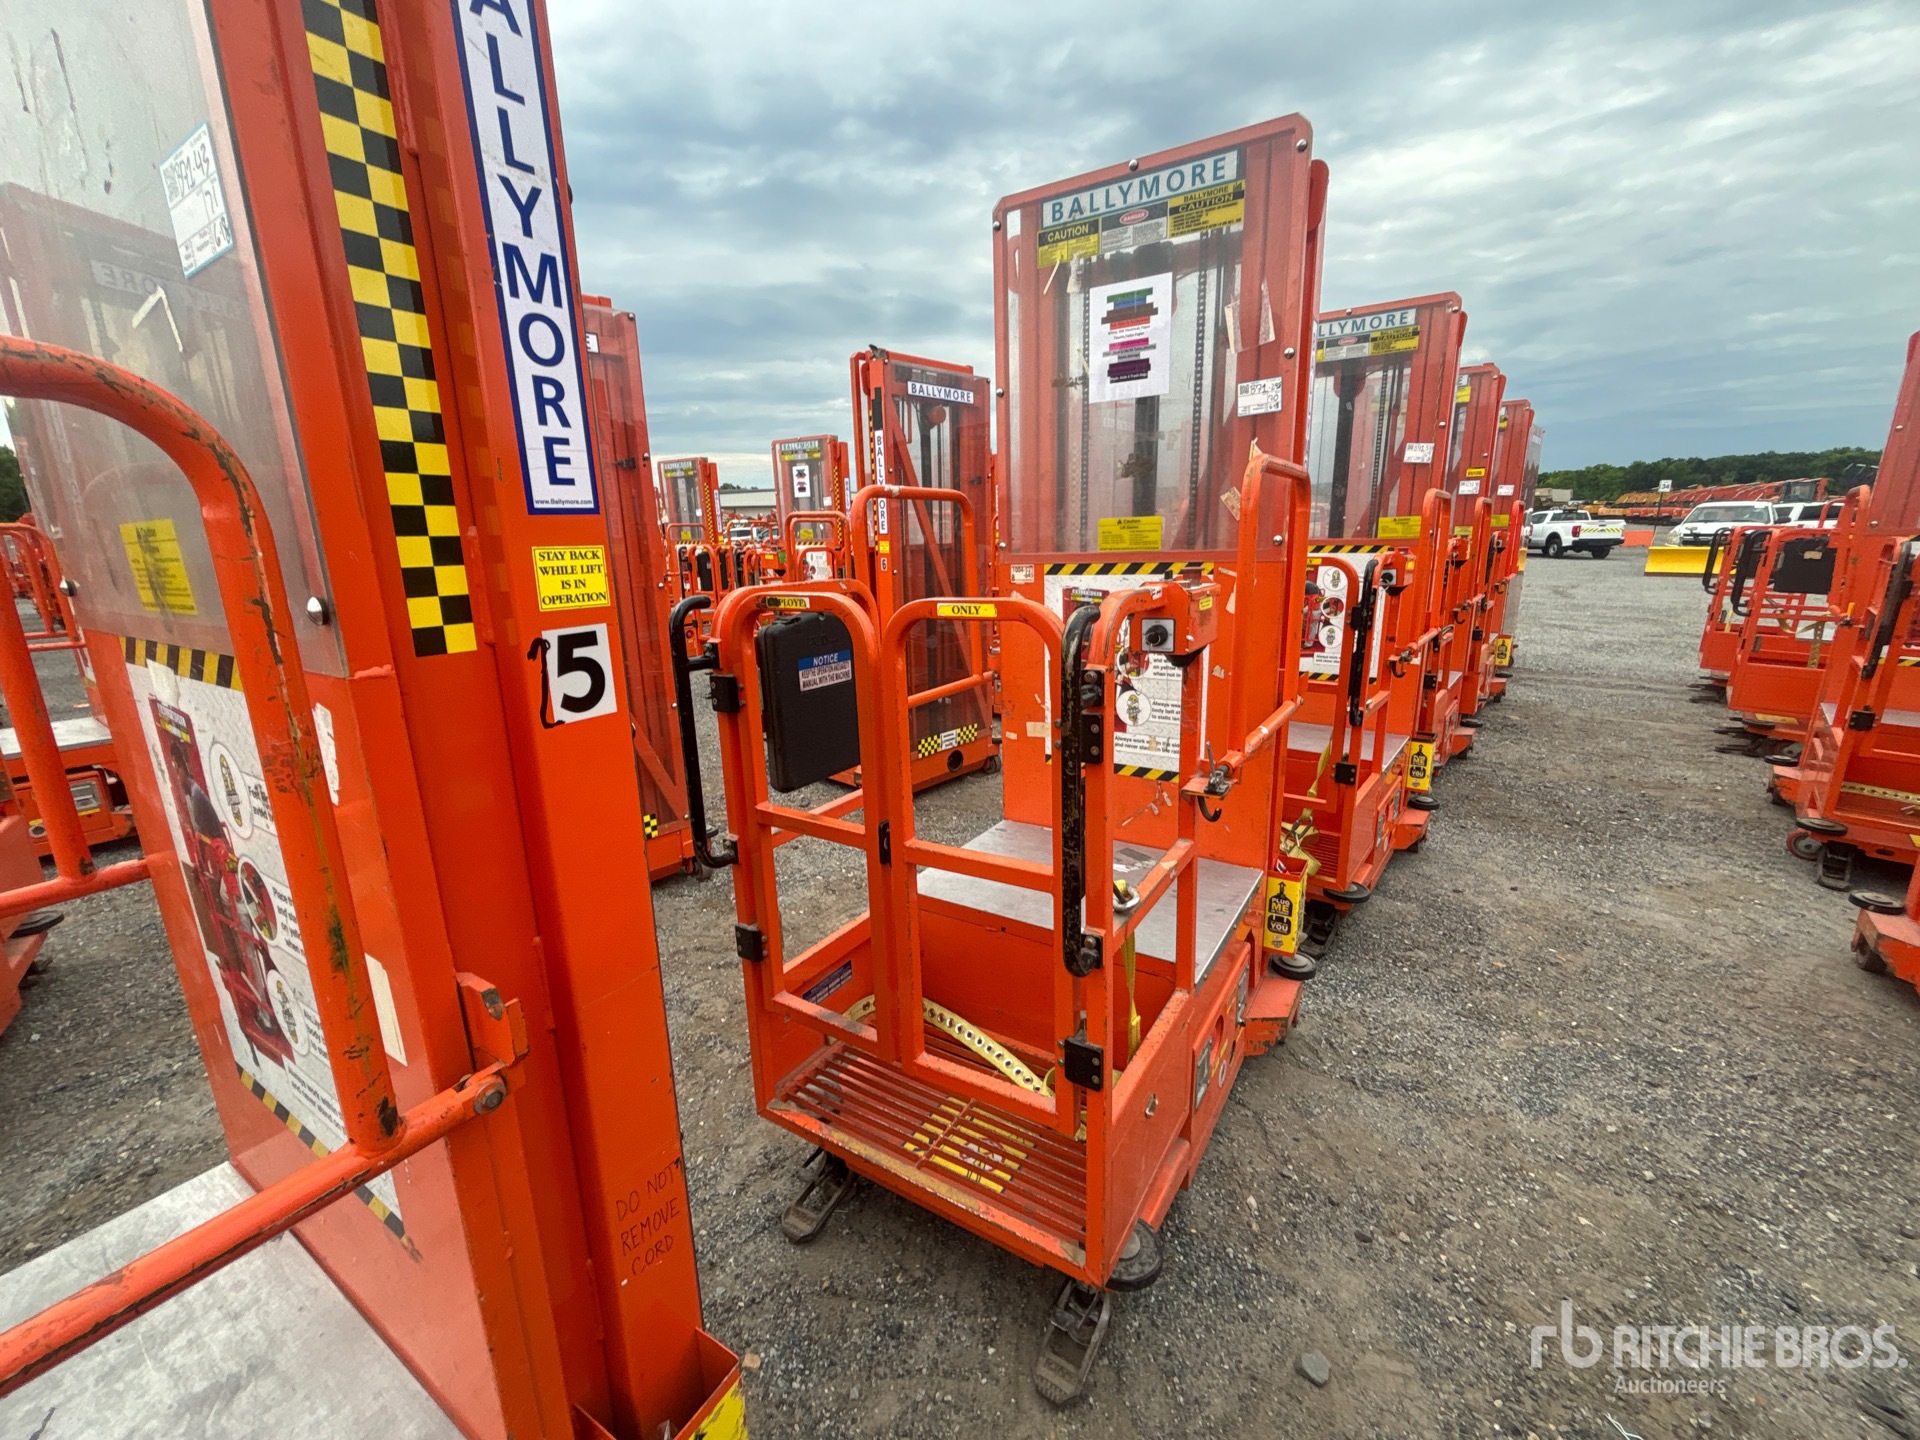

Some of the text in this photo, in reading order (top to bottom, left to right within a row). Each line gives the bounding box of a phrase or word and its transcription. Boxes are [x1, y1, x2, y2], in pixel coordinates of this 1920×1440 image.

[1051, 156, 1227, 223] BALLYMORE
[1178, 193, 1233, 213] CAUTION
[1047, 223, 1089, 242] CAUTION
[470, 0, 576, 487] ALLYMORE
[1318, 311, 1409, 337] LLYMORE
[911, 384, 971, 403] BALLYMORE
[877, 435, 887, 531] BALLYORE
[538, 550, 601, 562] STAY BACK
[539, 564, 603, 577] WHILE LIFT
[881, 559, 887, 570] 6
[561, 579, 587, 590] IS IN
[542, 592, 607, 606] OPERATION
[770, 597, 807, 608] PLOYE
[951, 604, 982, 615] ONLY
[813, 653, 839, 667] NOTICE
[1271, 897, 1290, 906] PLUG
[1271, 902, 1290, 912] ME
[1270, 921, 1288, 931] YOU
[616, 1161, 677, 1222] DO NOT
[620, 1197, 681, 1256] REMOVE
[631, 1235, 674, 1276] CORD
